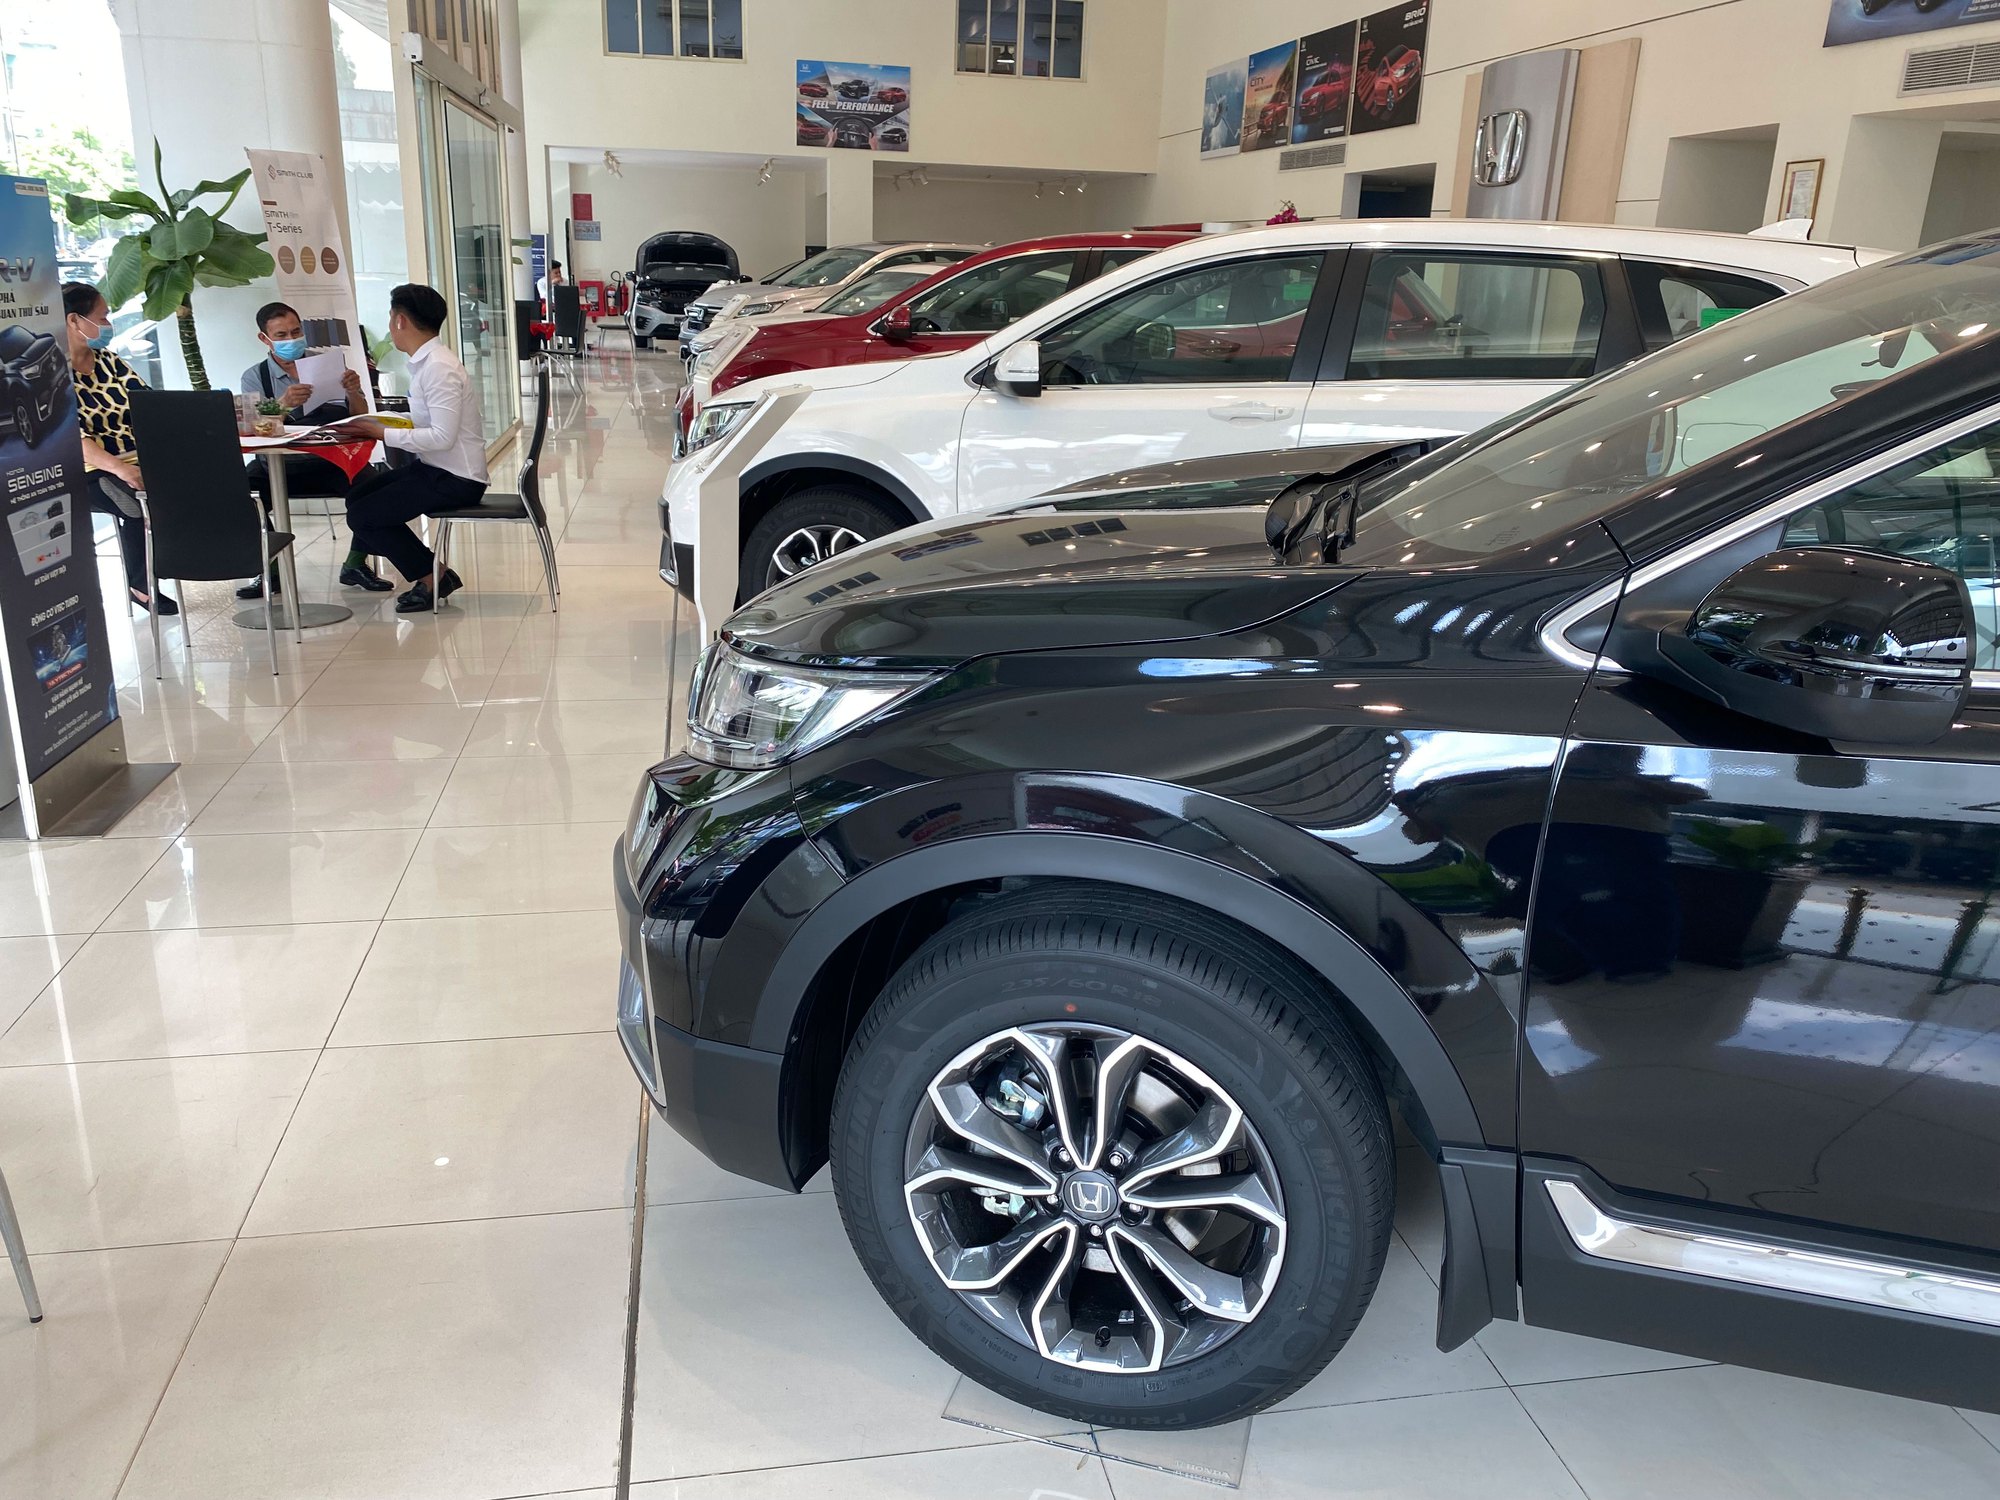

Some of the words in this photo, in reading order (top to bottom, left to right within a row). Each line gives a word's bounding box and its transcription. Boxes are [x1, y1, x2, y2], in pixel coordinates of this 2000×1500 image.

[1404, 7, 1427, 21] BRIO
[811, 99, 830, 109] FEEL
[836, 101, 895, 113] PERFORMANCE
[296, 171, 314, 179] CLUB
[264, 210, 289, 218] SMITH
[266, 221, 303, 234] T-Series
[7, 463, 63, 493] SENSING
[1309, 1148, 1351, 1326] MICHELIN
[1186, 1463, 1231, 1480] HONDA
